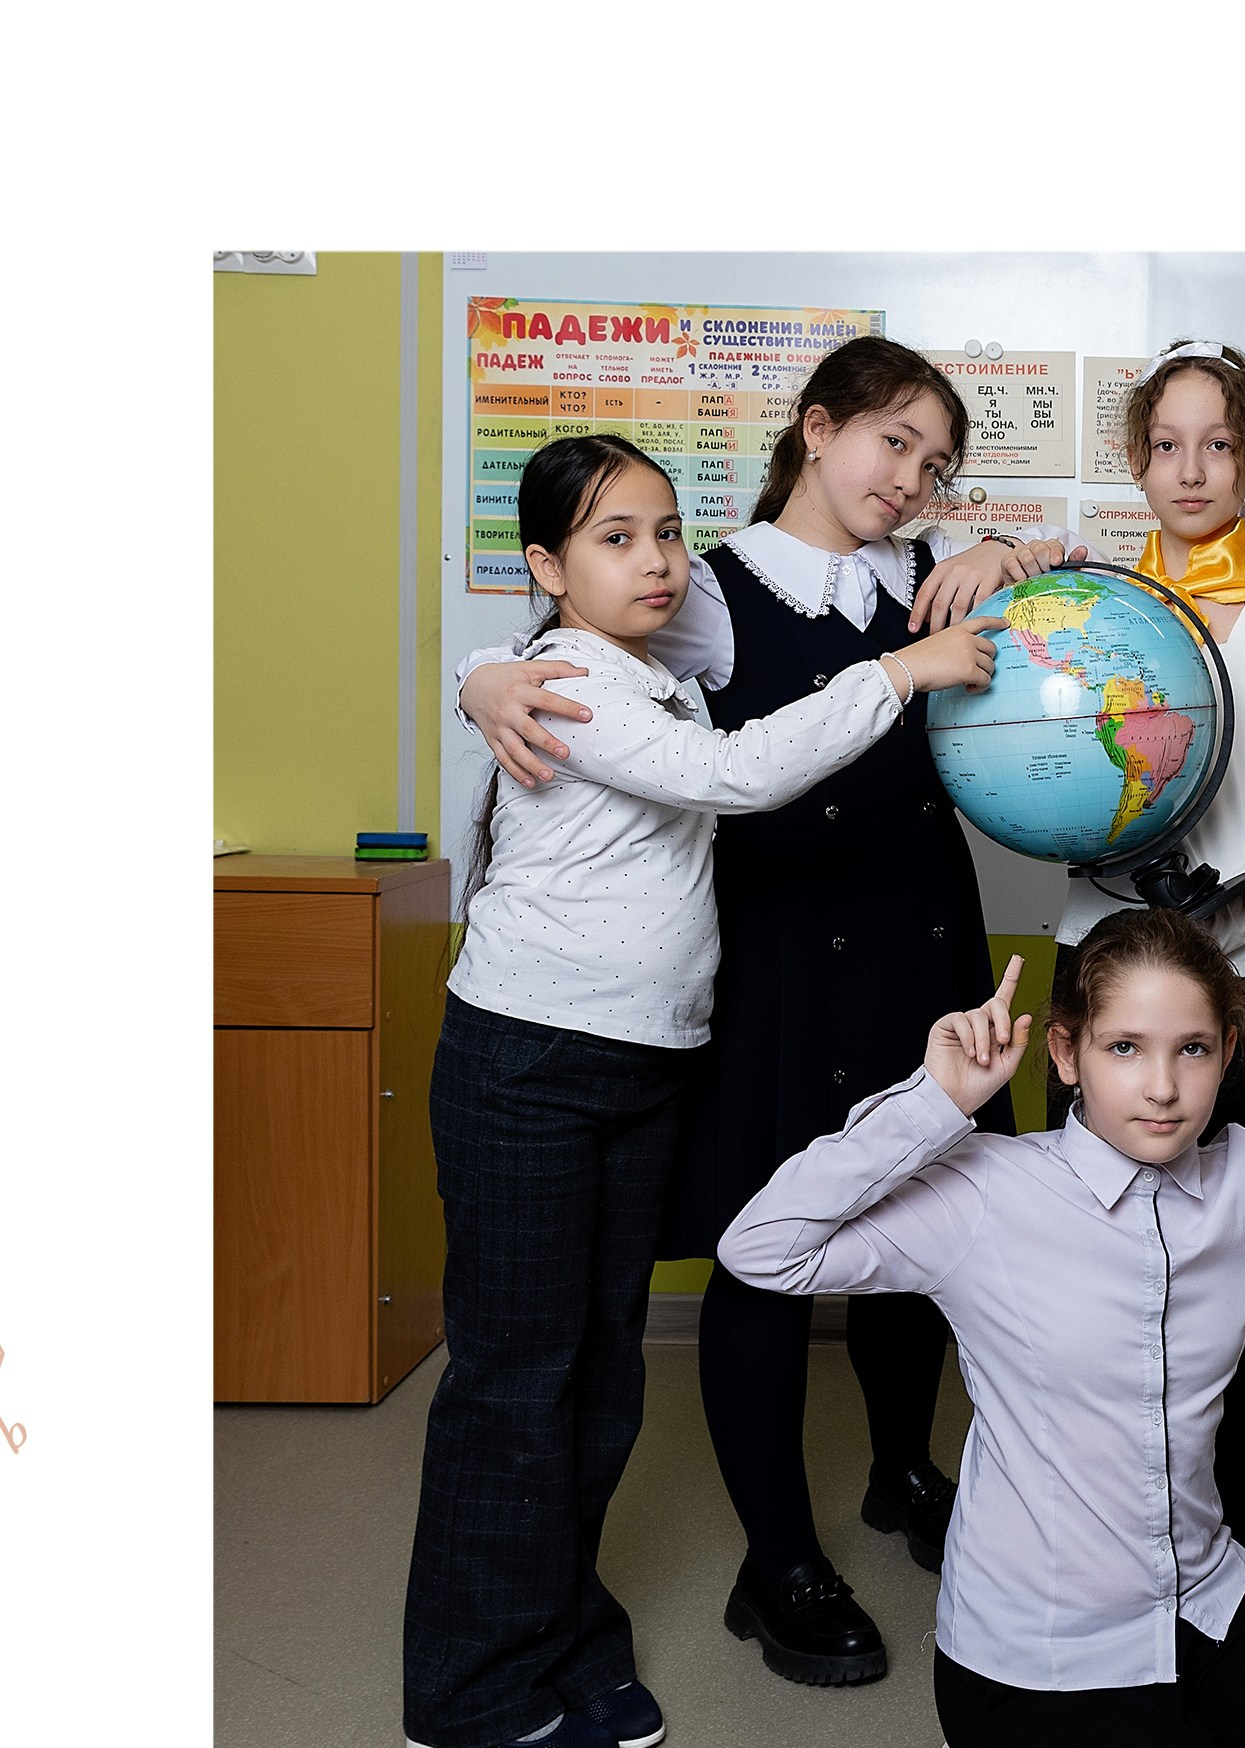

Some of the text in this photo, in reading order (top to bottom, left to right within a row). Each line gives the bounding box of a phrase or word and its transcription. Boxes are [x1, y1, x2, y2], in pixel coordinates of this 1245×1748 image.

[502, 312, 857, 346] ПАДЕЖИ И СКЛОНЕНИЯ ИМЁН
[703, 335, 850, 350] СУЩЕСТВИТЕЛЬНЫ
[476, 352, 544, 371] ПАДЕЖ
[709, 352, 781, 362] ПАДЕЖНЫЕ
[688, 363, 695, 375] 1
[698, 363, 743, 371] СКЛОНЕНИЕ
[751, 365, 760, 376] 2
[934, 363, 1049, 376] ЕСТОИМЕНИЕ
[553, 372, 593, 382] ВОПРОС
[598, 374, 631, 382] СЛОВО
[641, 375, 684, 384] ПРЕДЛОГ
[699, 372, 718, 380] Ж.Р.
[560, 391, 586, 400] КТО?
[978, 386, 1008, 396] ЕД.Ч.
[1026, 386, 1059, 396] МН.Ч.
[475, 395, 548, 406] ИМЕНИТЕЛЬНЫЙ
[701, 396, 732, 405] ПАПА
[989, 400, 997, 408] Я
[1032, 400, 1052, 408] МЫ
[560, 404, 586, 413] ЧТО?
[697, 408, 737, 418] БАШНЯ
[984, 410, 1002, 418] ТЫ
[1034, 410, 1051, 418] ВЫ
[991, 420, 1018, 430] ОНА,
[1030, 420, 1055, 428] ОНИ
[477, 428, 547, 438] РОДИТЕЛЬНЫЙ
[555, 425, 590, 434] КОГО?
[700, 428, 733, 438] ПАПЫ
[980, 432, 1006, 440] ОНО
[696, 442, 736, 450] БАШНИ
[702, 460, 732, 469] ПАПЕ
[698, 473, 735, 482] БАШНЕ
[701, 496, 731, 505] ПАПУ
[984, 503, 1042, 512] ГЛАГОЛОВ
[696, 508, 737, 518] БАШНЮ
[1099, 510, 1160, 520] СПРЯЖЕНИ
[992, 514, 1044, 522] ВРЕМЕНИ
[976, 526, 1000, 536] спр.
[1110, 530, 1148, 538] спряже
[476, 566, 529, 576] ПРЕДЛОЖН
